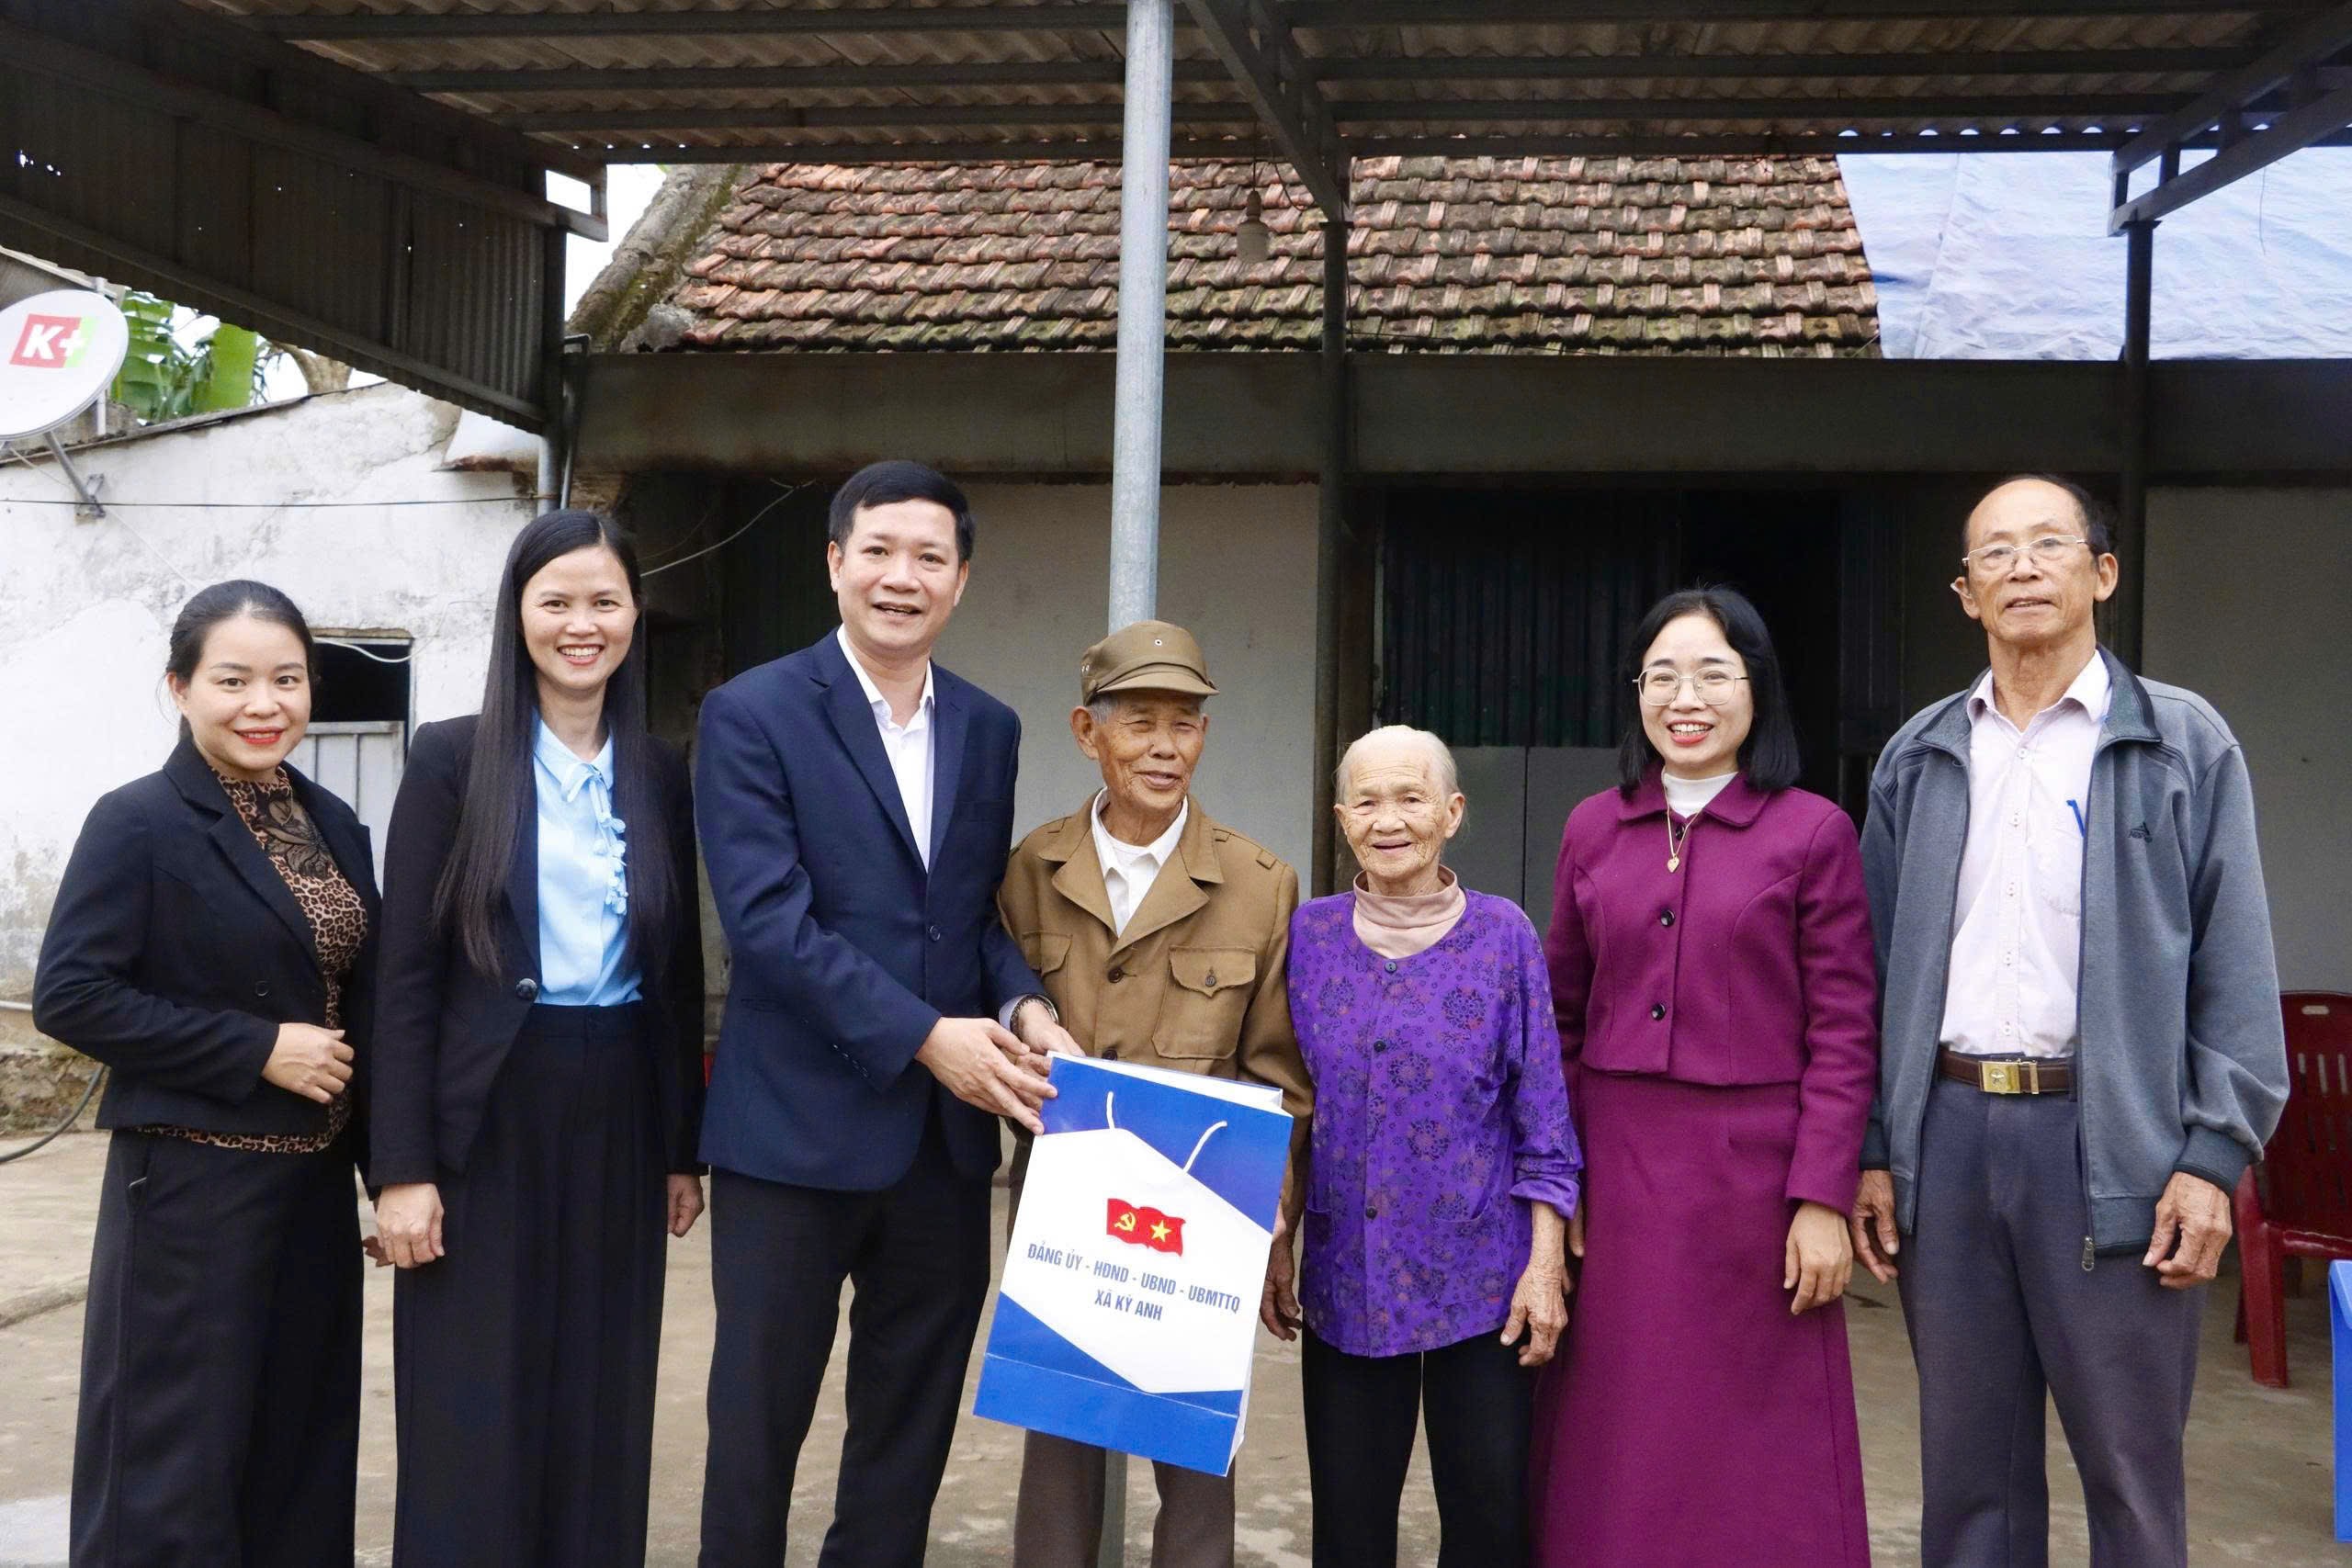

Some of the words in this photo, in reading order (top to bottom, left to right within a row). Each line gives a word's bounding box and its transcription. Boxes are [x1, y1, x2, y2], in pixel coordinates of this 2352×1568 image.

[22, 323, 86, 360] K+
[1027, 1240, 1063, 1266] ĐẢNG
[1066, 1248, 1083, 1270] ỦY
[1093, 1260, 1129, 1282] HĐND
[1141, 1272, 1176, 1295] UBND
[1188, 1284, 1240, 1314] UBMTTQ
[1094, 1288, 1112, 1308] XÃ
[1114, 1293, 1133, 1313] KỲ
[1135, 1301, 1163, 1321] ANH
